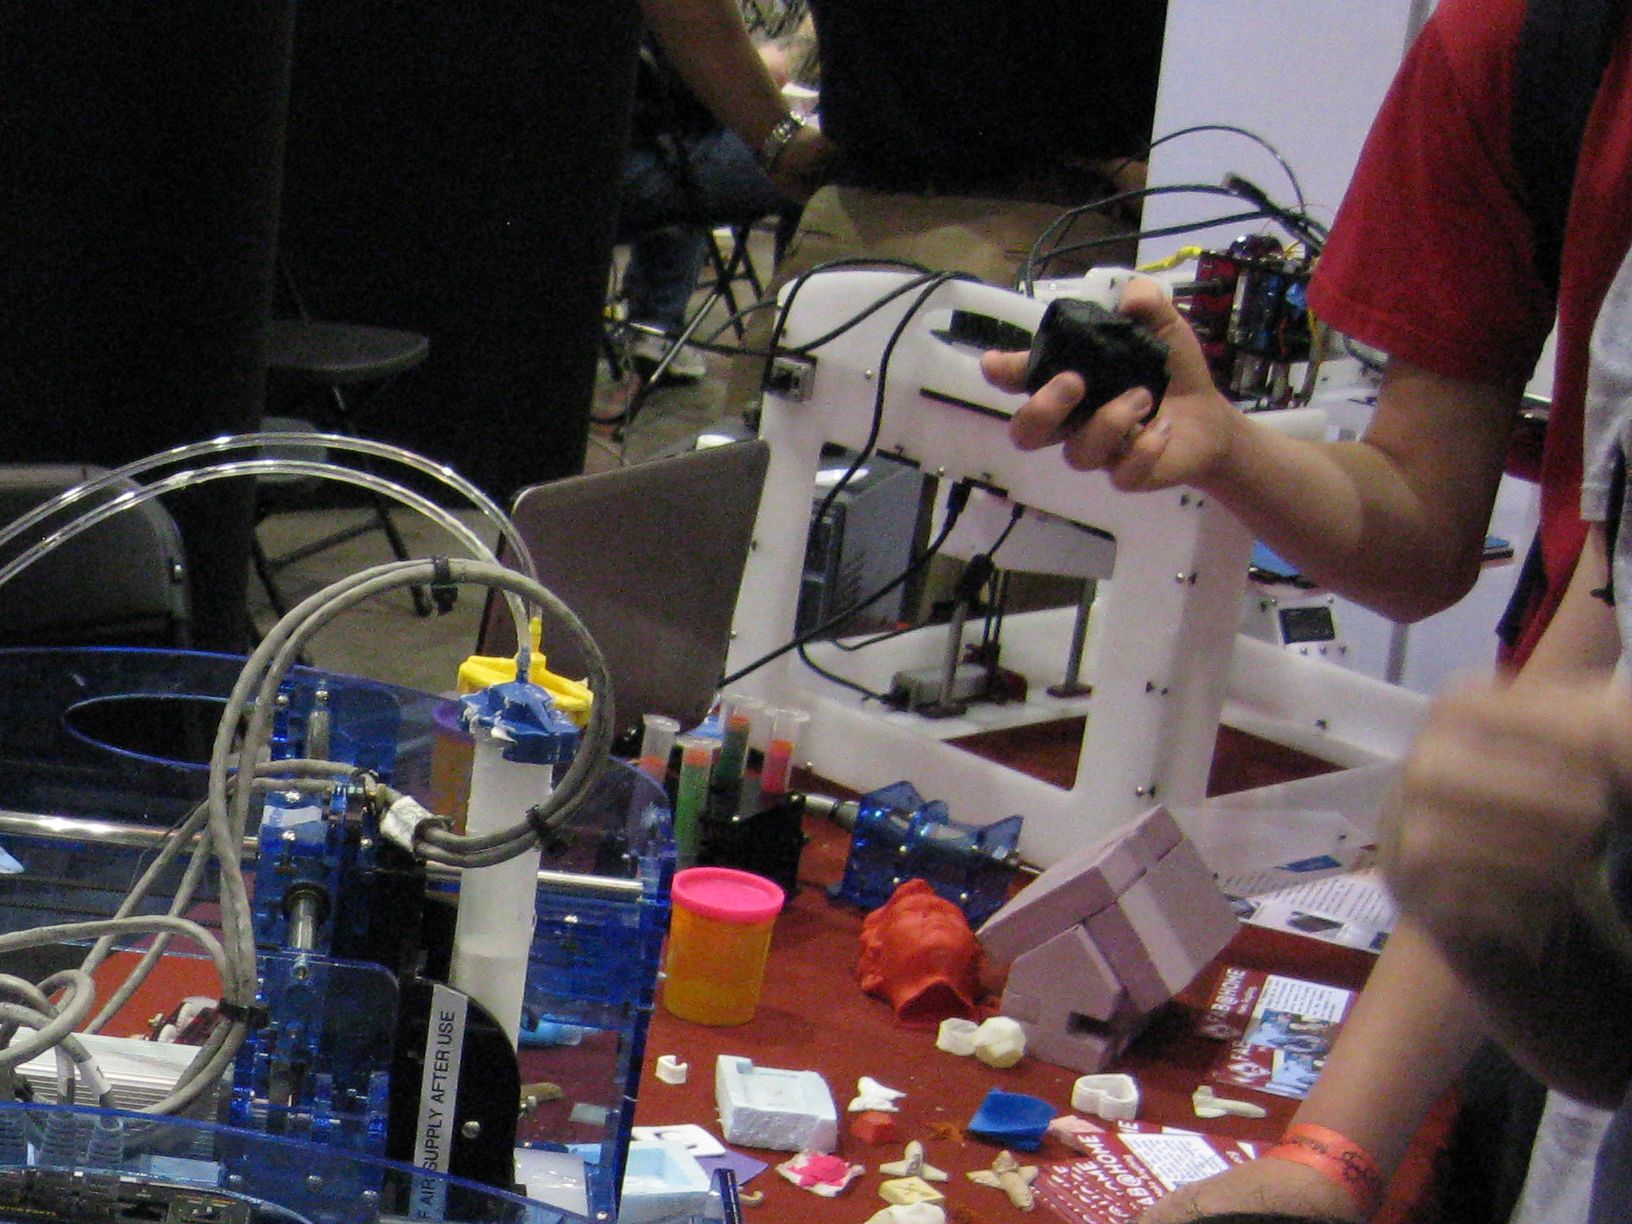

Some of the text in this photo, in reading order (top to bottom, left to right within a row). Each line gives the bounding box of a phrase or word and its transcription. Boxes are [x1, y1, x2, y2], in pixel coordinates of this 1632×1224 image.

[437, 1010, 456, 1046] USE
[431, 1050, 450, 1104] AFTER
[423, 1109, 443, 1170] SUPPLY
